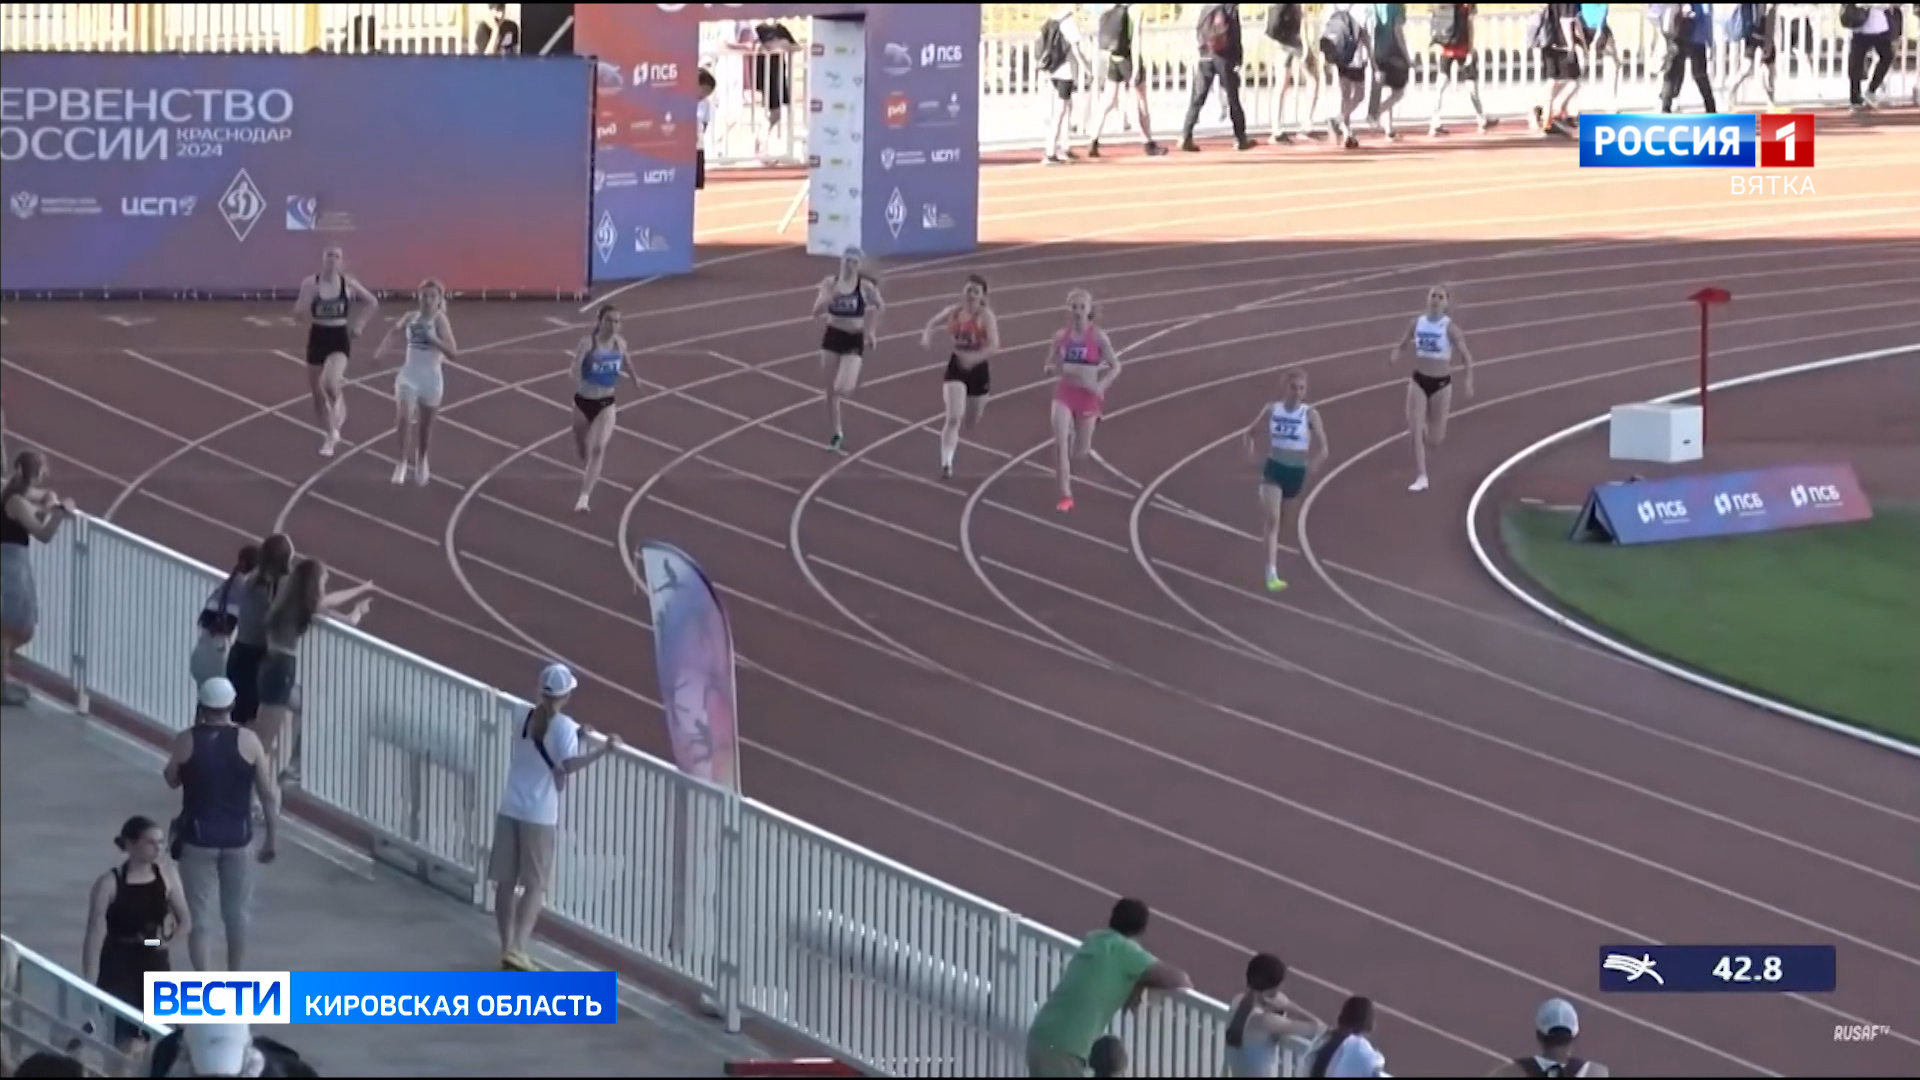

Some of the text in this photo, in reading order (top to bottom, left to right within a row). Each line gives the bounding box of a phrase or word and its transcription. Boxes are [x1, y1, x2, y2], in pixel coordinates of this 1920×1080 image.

[937, 45, 963, 63] ПСБ
[650, 64, 678, 81] ПСБ
[1, 88, 294, 123] ЕРВЕНСТВО
[1, 127, 168, 161] ОССИИ
[176, 128, 293, 144] КРАСНОДАР
[176, 143, 223, 158] 2024
[122, 197, 177, 217] ЦСП
[1732, 492, 1763, 511] ПСБ
[1810, 484, 1841, 502] ПСБ
[1658, 499, 1687, 518] ПСБ
